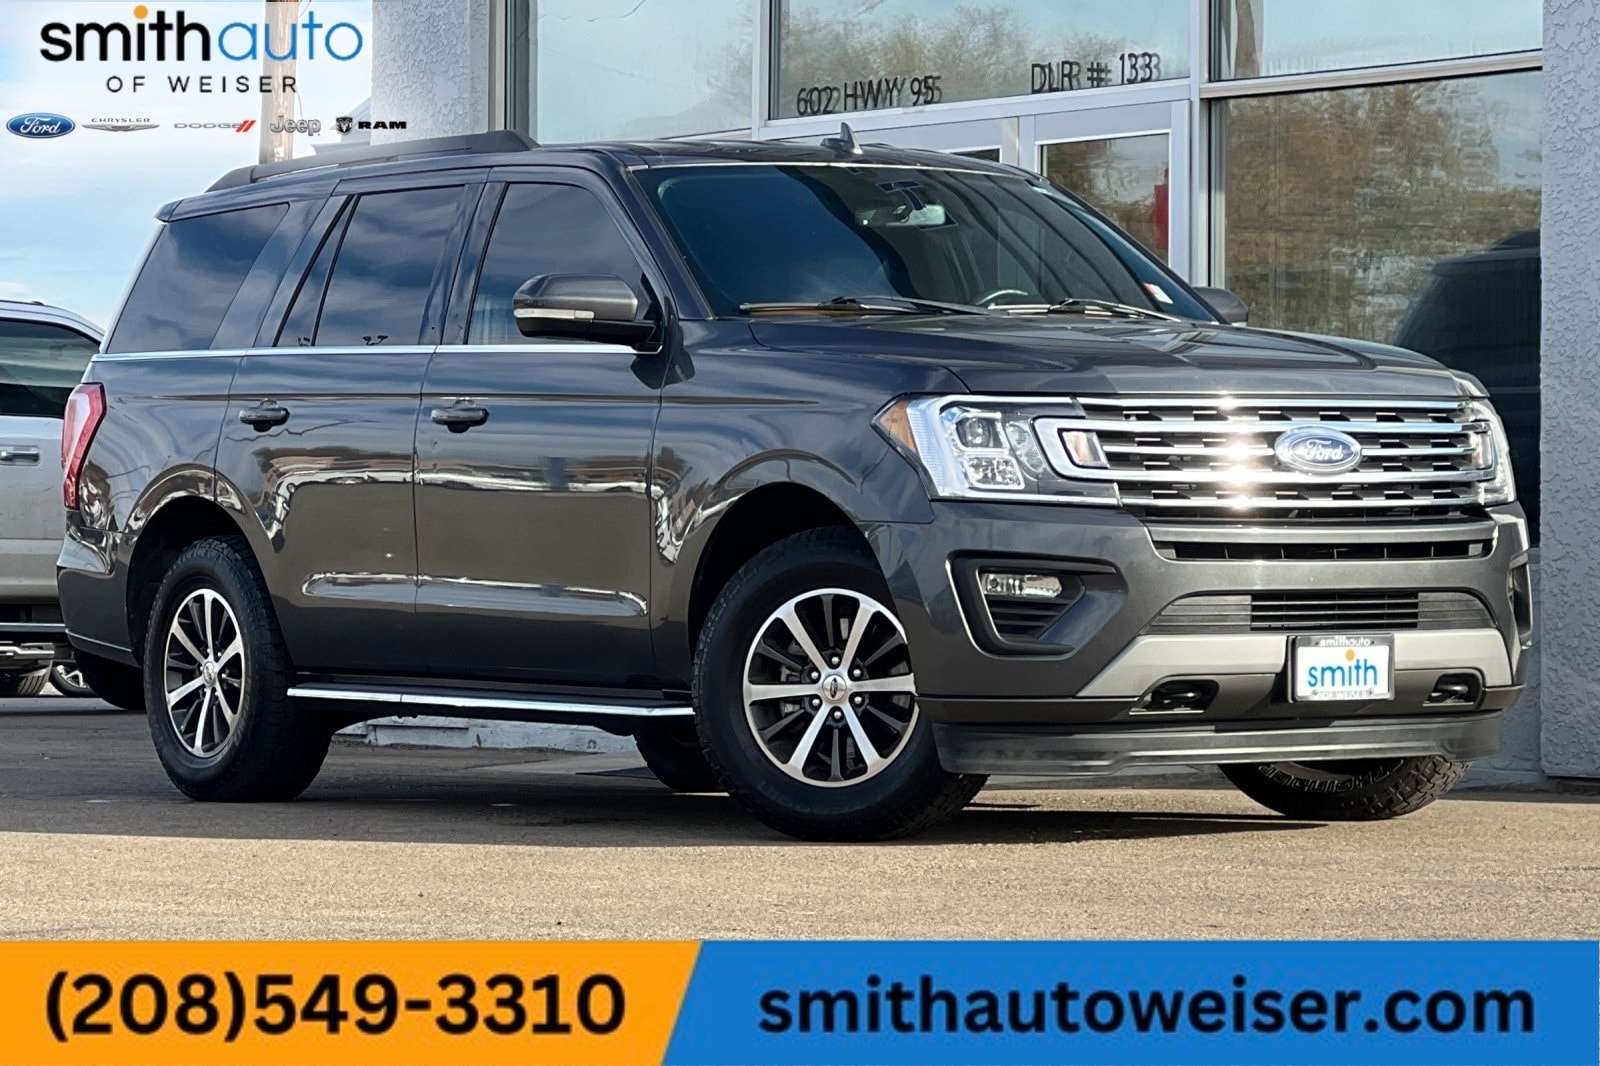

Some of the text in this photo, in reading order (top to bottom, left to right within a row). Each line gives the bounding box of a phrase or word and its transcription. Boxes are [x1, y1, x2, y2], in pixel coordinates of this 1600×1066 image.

[1031, 60, 1077, 94] DLR
[797, 75, 935, 115] 602 HWY 95
[1301, 438, 1344, 461] Ford
[1319, 635, 1371, 647] smithauto
[1307, 649, 1378, 687] smith
